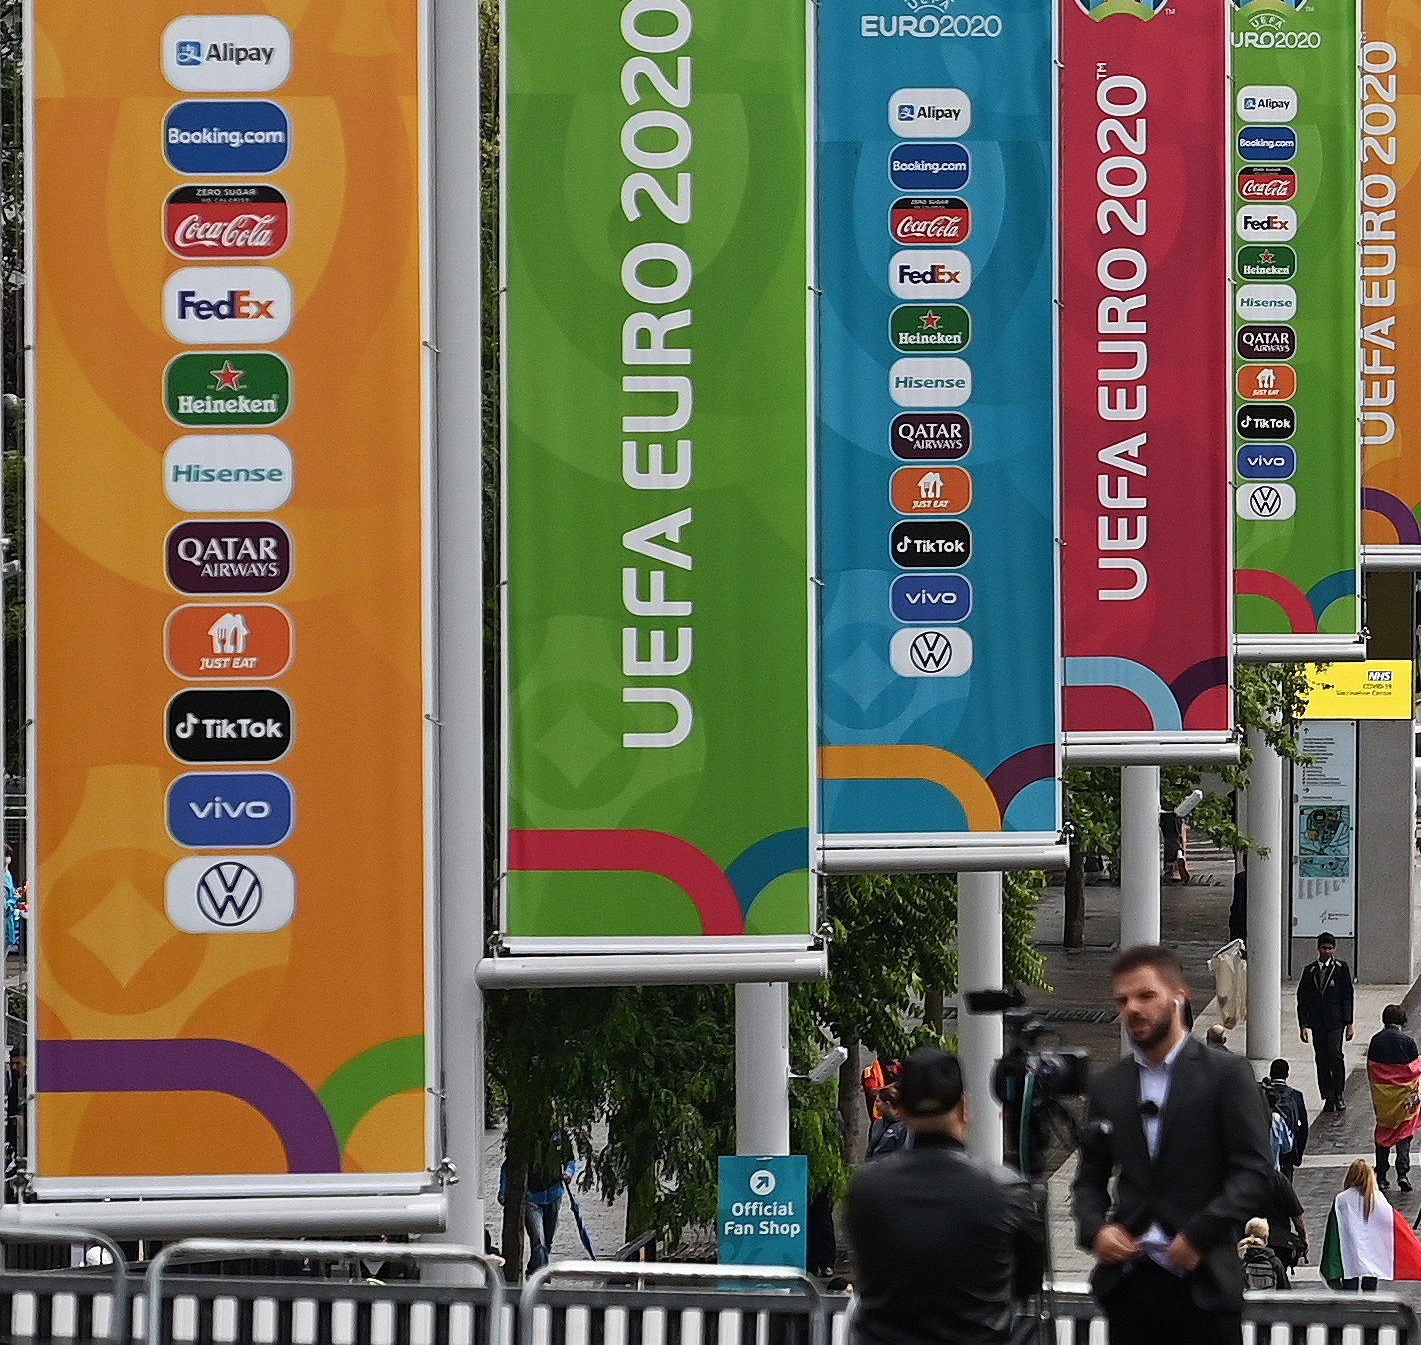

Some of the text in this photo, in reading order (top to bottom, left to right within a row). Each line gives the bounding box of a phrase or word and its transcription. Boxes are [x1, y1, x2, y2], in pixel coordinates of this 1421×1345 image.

[861, 15, 1002, 37] EURO2020
[1230, 32, 1320, 49] URO2020
[205, 42, 276, 66] Alipay
[1257, 98, 1290, 110] Alipay
[917, 105, 961, 121] Alipay
[168, 127, 285, 148] Booking.com
[1240, 138, 1294, 149] Booking.com
[892, 160, 967, 175] Booking.com
[174, 214, 276, 247] Coca-Cola
[897, 216, 962, 237] Coca-Cola
[1243, 216, 1289, 231] FedEx
[1360, 41, 1397, 445] UEFA EURO 2020
[898, 265, 960, 284] FedEx
[1243, 265, 1290, 275] Heineken
[177, 290, 275, 319] FedEx
[1240, 297, 1292, 308] Hisense
[898, 332, 962, 344] Heineken
[1096, 247, 1149, 421] EURO
[1242, 333, 1290, 346] QATAR
[620, 242, 694, 490] EURO
[895, 376, 965, 389] Hisense
[177, 395, 277, 414] Heineken
[898, 423, 962, 441] QATAR
[1253, 418, 1291, 429] TikTok
[914, 440, 963, 450] AIRWAYS
[1247, 455, 1285, 466] vivo
[172, 465, 283, 483] Hisense
[1097, 432, 1149, 601] UEFA
[177, 536, 278, 565] QATAR
[914, 539, 965, 553] TikTok
[201, 562, 280, 578] AIRWAYS
[905, 589, 957, 604] vivo
[622, 507, 694, 748] UEFA
[199, 657, 257, 670] JUST EAT
[1369, 671, 1391, 681] NHS
[202, 717, 283, 739] TikTok
[189, 796, 271, 818] vivo
[731, 1202, 794, 1217] Official
[724, 1221, 800, 1238] Fan Shop
